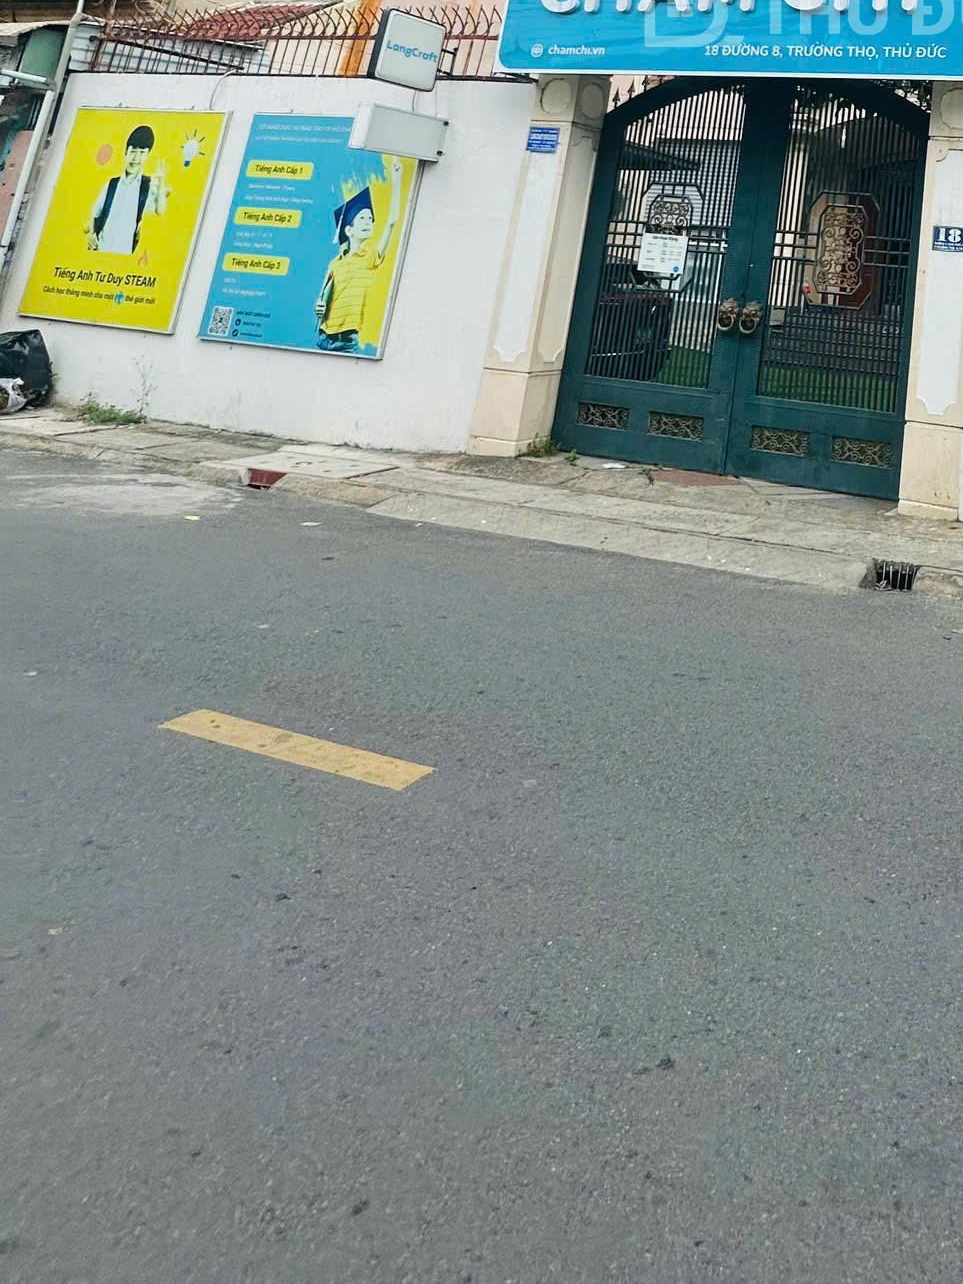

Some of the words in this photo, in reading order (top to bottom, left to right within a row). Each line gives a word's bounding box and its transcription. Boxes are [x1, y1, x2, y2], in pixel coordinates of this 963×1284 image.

[387, 39, 438, 63] LangCraft
[548, 44, 606, 56] chamchi.vn
[704, 46, 718, 56] 18
[721, 44, 769, 57] ĐƯỜNG
[771, 47, 783, 58] 8,
[787, 44, 843, 57] TRƯỜNG
[847, 46, 878, 60] THỌ,
[883, 43, 912, 58] THỦ
[915, 44, 947, 59] ĐỨC
[272, 165, 285, 173] Anh
[261, 213, 273, 221] Anh
[937, 227, 962, 243] 18
[249, 259, 262, 268] Anh
[54, 267, 76, 281] Tiếng
[77, 269, 93, 280] Anh
[95, 271, 106, 282] Tư
[107, 273, 123, 287] Duy
[125, 274, 157, 287] STEAM
